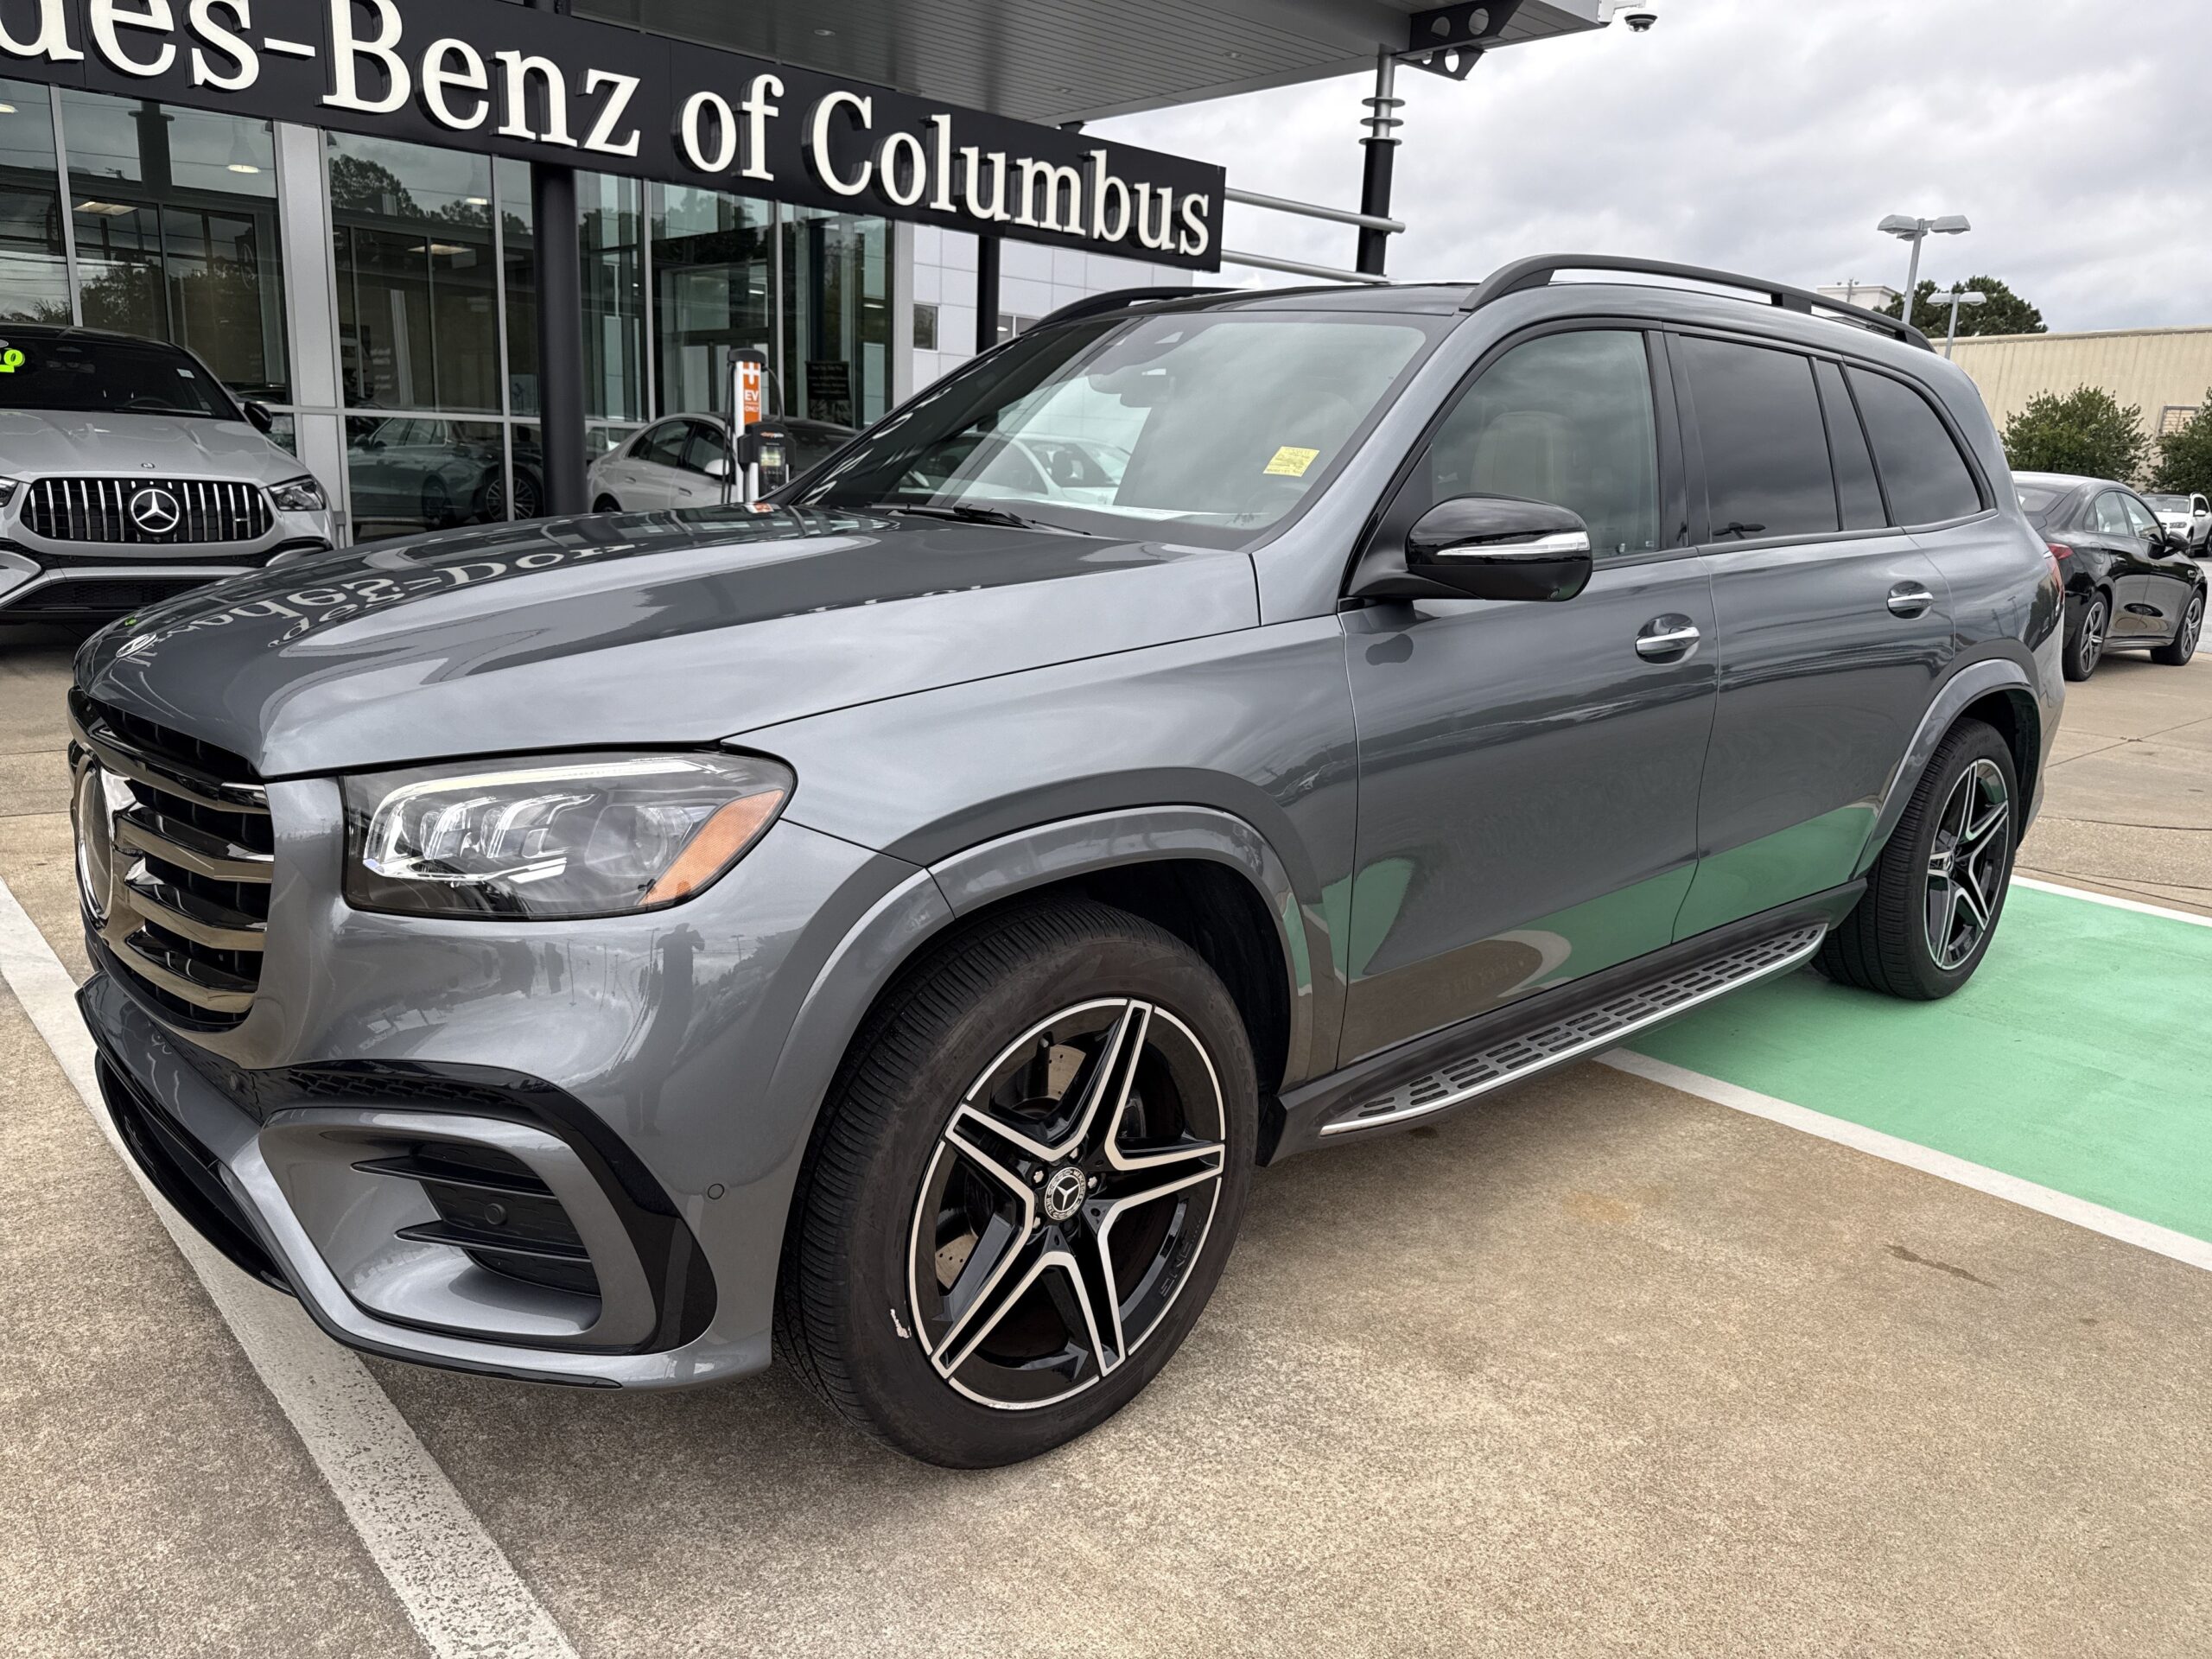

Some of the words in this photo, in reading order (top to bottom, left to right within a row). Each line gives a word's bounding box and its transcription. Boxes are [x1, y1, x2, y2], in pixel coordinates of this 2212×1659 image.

[681, 73, 785, 181] of
[812, 91, 1210, 256] Columbus
[744, 390, 760, 402] EV
